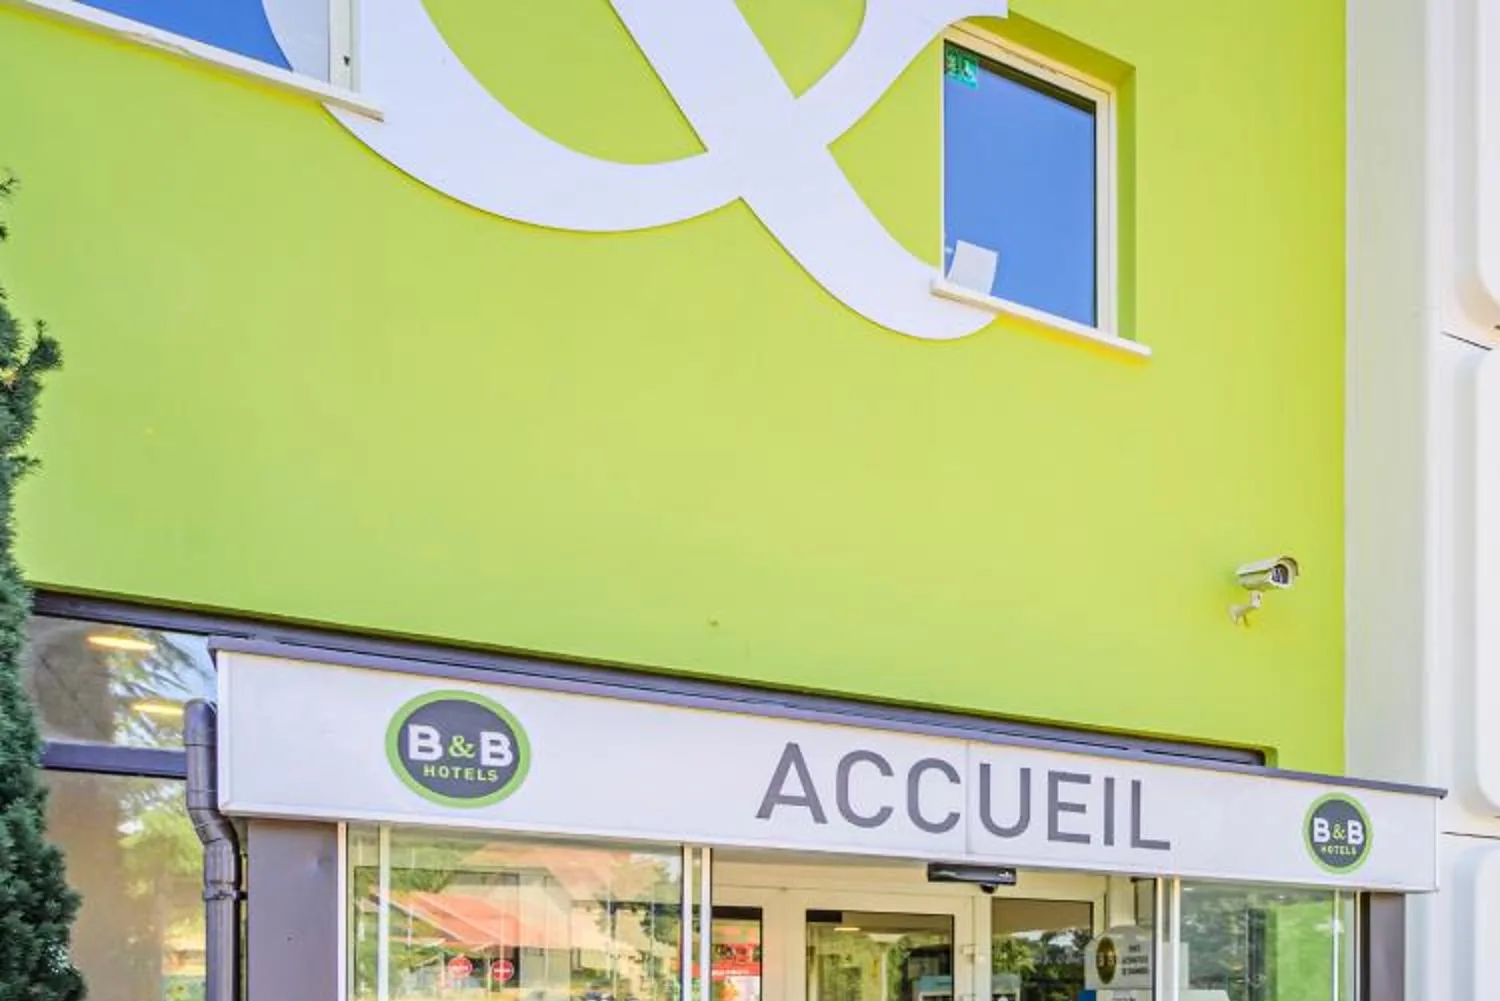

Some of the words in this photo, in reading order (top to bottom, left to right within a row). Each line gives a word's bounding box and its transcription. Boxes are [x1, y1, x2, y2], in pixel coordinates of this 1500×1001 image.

[408, 723, 513, 767] B&B
[423, 764, 498, 782] HOTELS
[755, 742, 1171, 851] ACCUEIL
[1313, 817, 1365, 844] B&B
